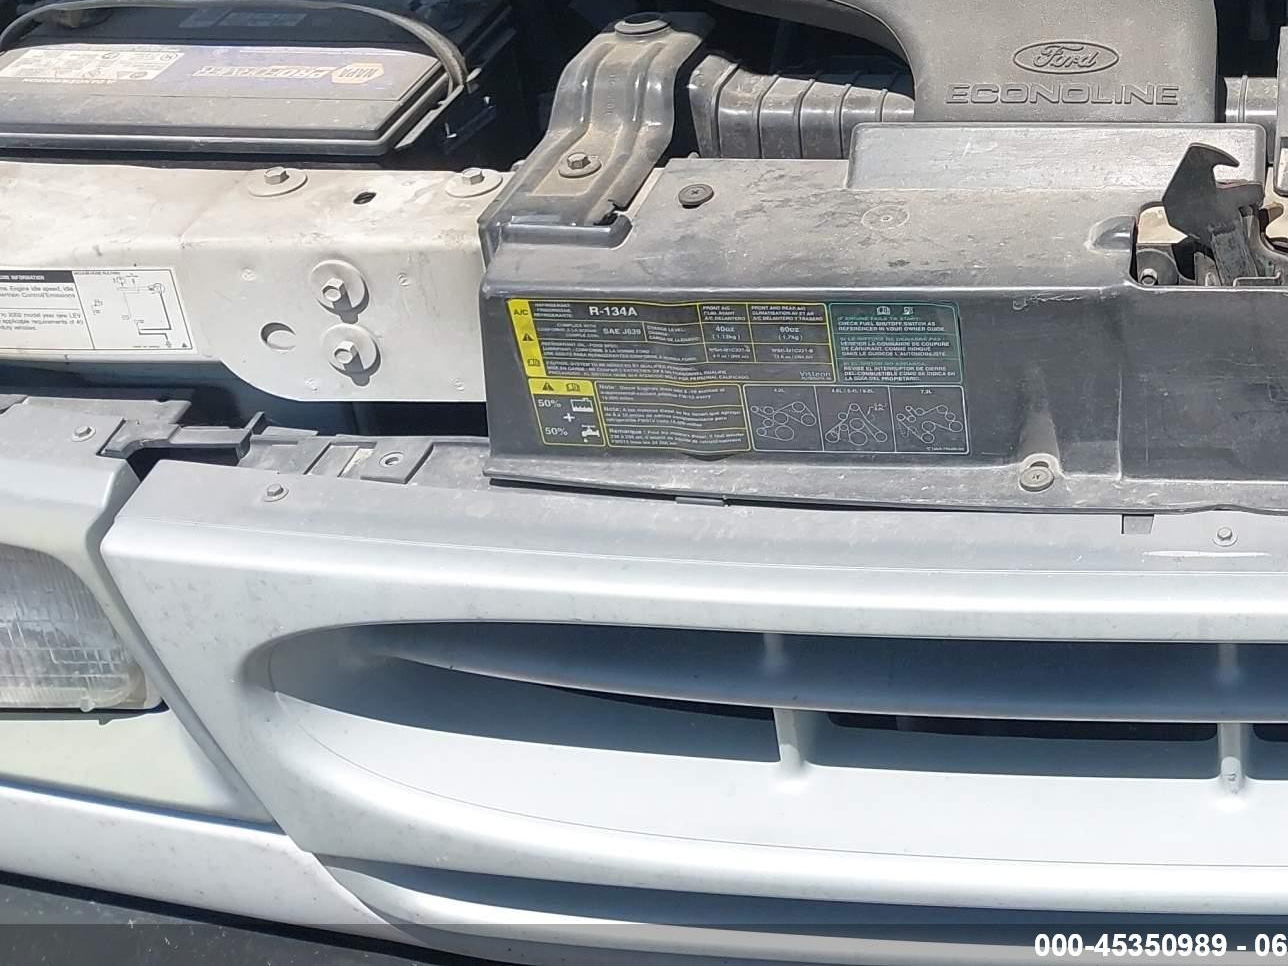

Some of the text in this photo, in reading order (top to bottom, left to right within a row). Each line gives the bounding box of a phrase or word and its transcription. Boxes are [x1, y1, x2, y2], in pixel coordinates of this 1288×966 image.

[1033, 44, 1100, 68] Ford
[946, 82, 1180, 105] ECONOLINE
[589, 306, 637, 316] R-134A
[537, 399, 562, 408] 50%
[545, 427, 568, 436] 50%
